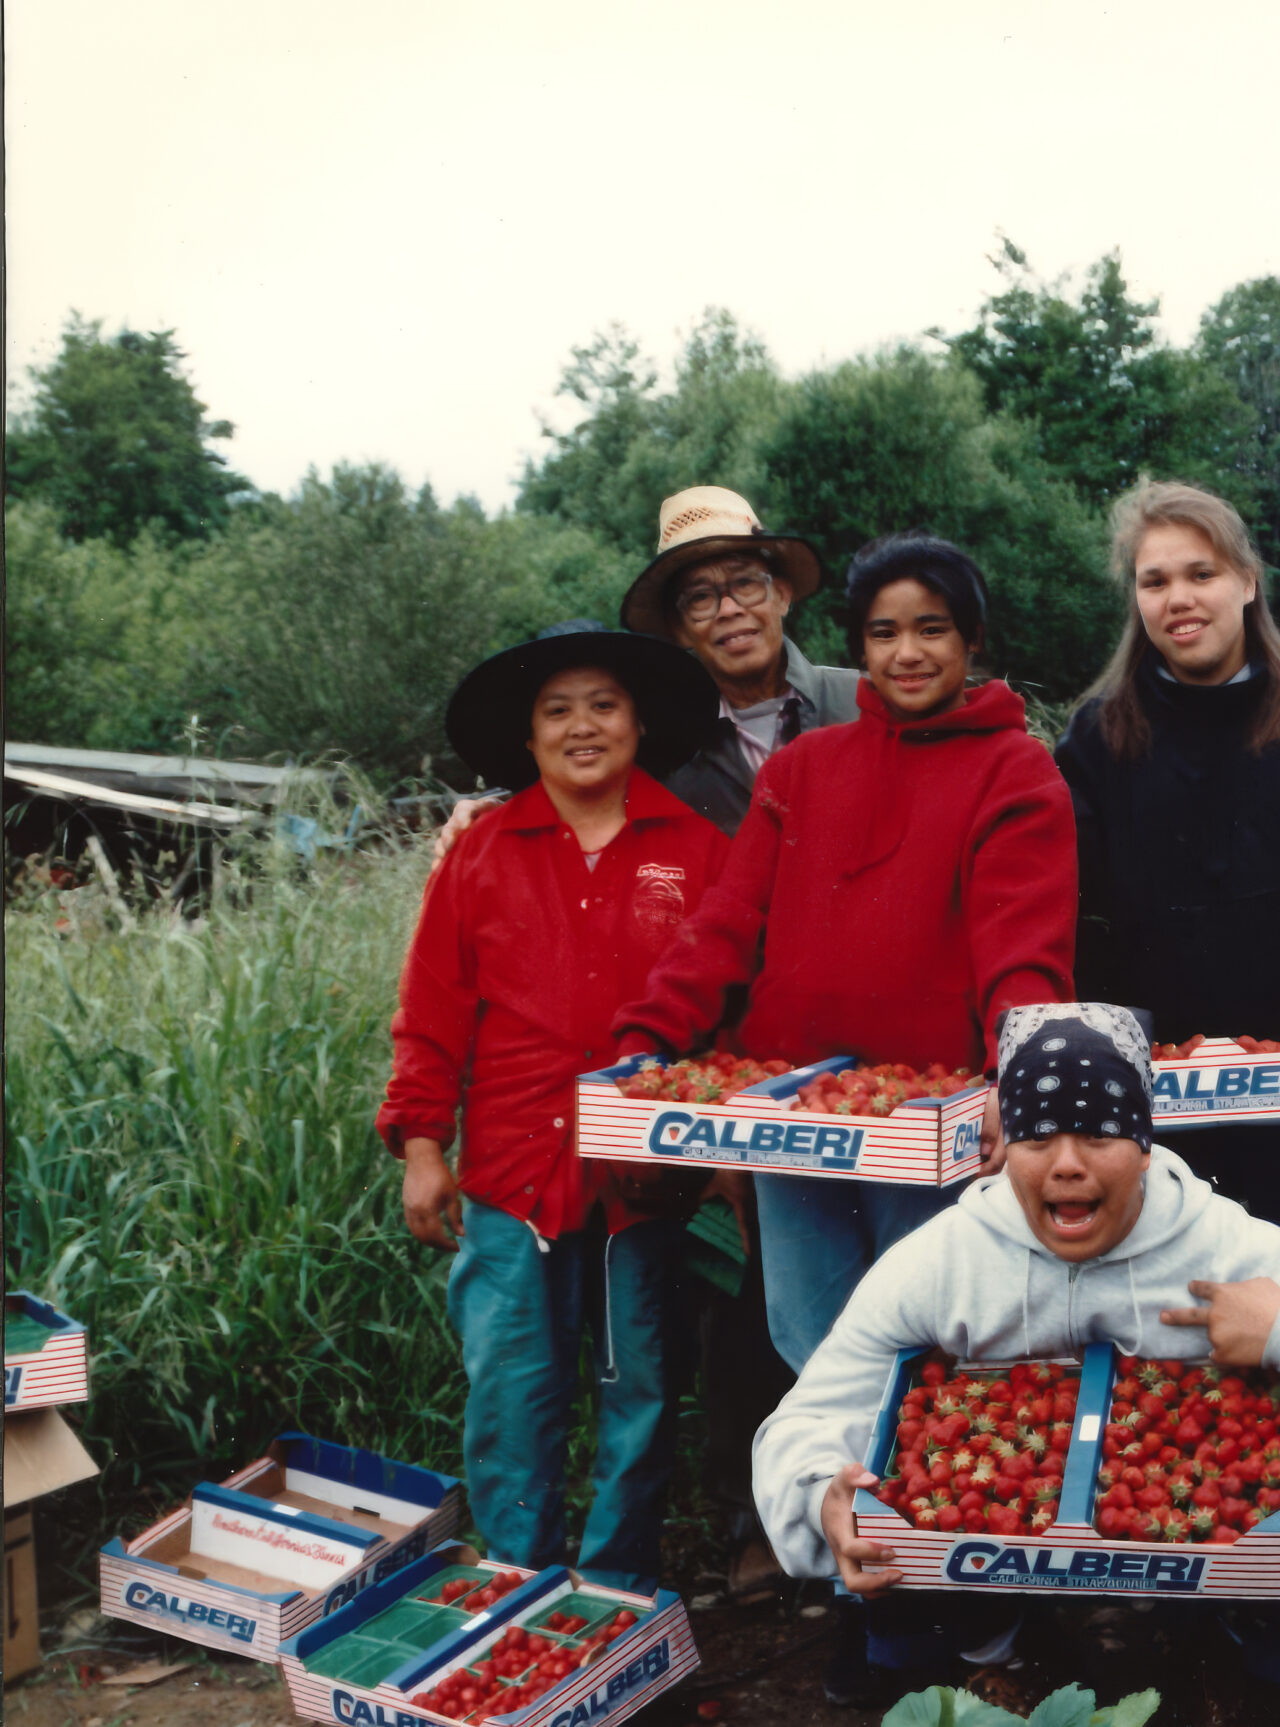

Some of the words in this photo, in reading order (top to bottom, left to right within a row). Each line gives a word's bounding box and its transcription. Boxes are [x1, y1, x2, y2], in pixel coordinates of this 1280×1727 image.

[649, 1111, 865, 1170] CALBERI
[946, 1541, 1206, 1591] CALBERI
[125, 1582, 257, 1643] CALBERI
[333, 1689, 430, 1727] CALB
